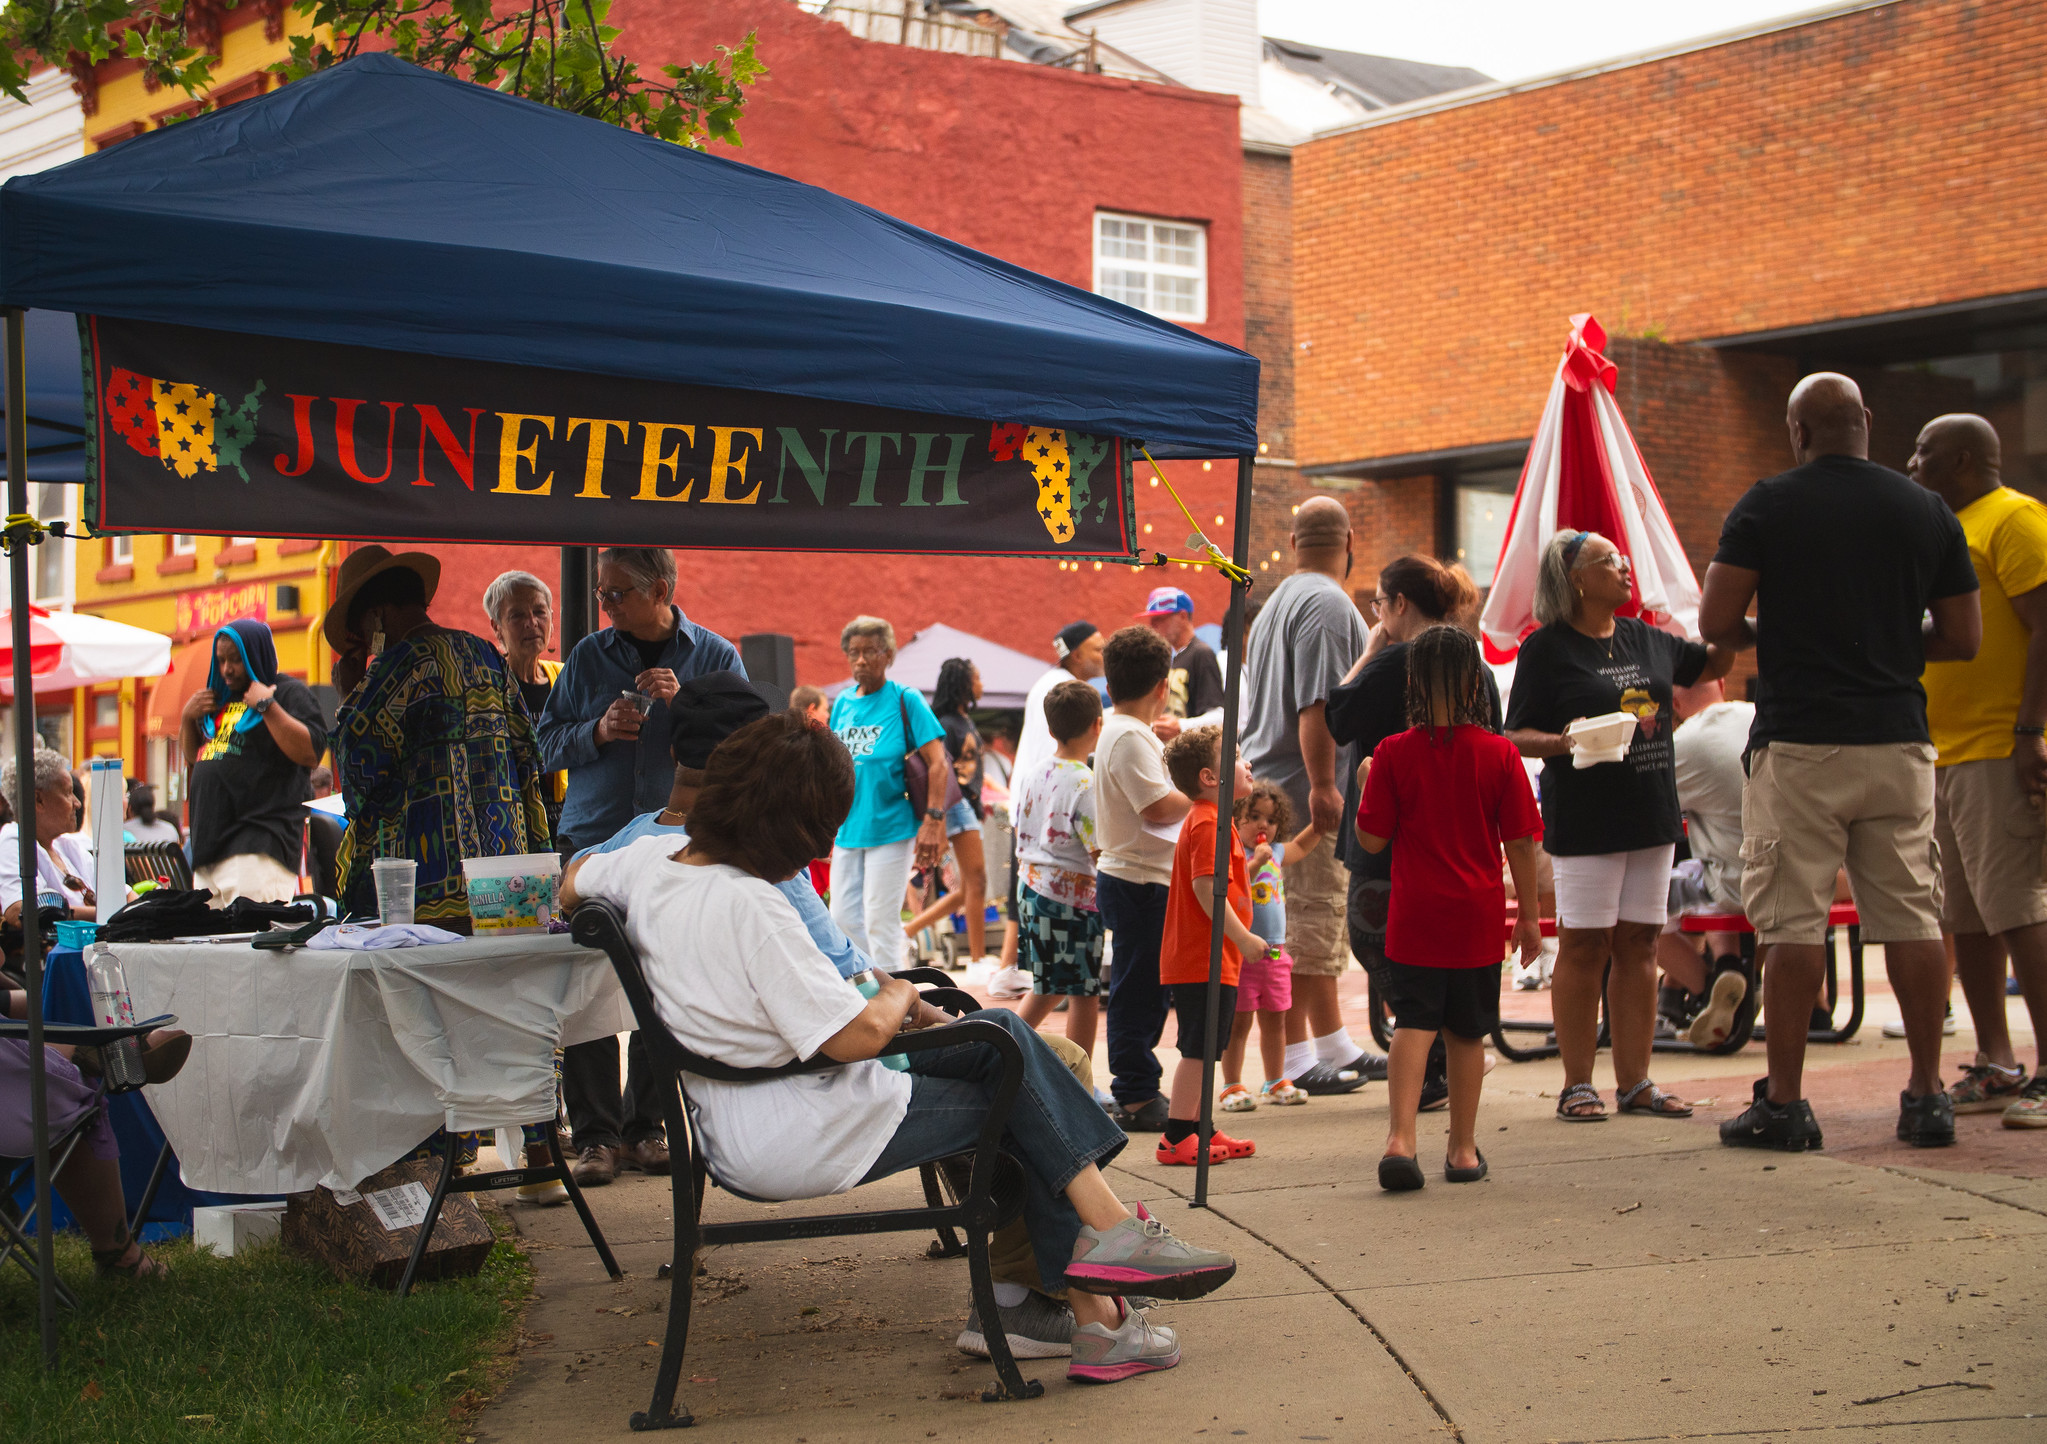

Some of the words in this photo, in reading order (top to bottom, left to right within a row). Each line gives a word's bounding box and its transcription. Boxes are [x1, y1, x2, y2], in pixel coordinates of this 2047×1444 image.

[273, 393, 975, 508] JUNETEENTH
[200, 584, 266, 626] POPCORN
[1631, 740, 1668, 753] ELEBRATING
[471, 891, 506, 906] VANILLA
